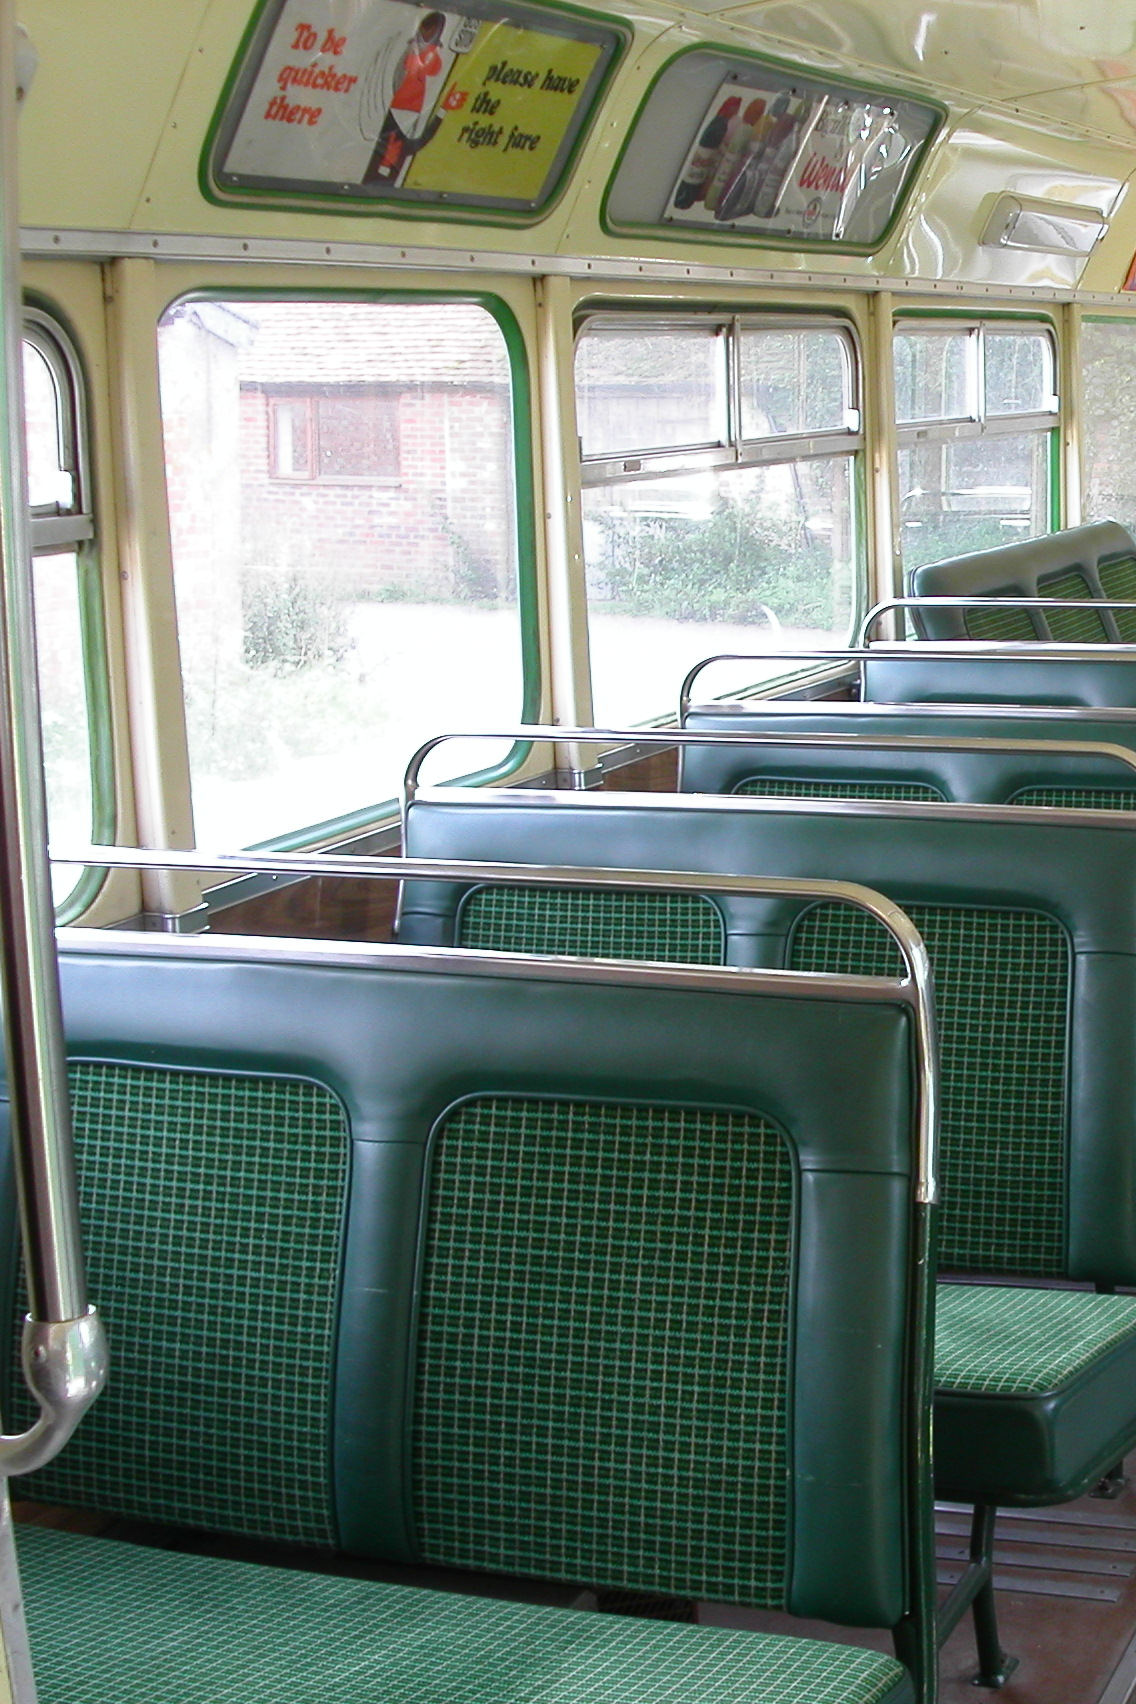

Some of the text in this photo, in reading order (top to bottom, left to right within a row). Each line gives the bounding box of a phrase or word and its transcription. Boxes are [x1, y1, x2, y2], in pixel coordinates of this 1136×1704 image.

[292, 23, 347, 56] To be
[278, 63, 358, 93] quicker
[484, 60, 580, 94] please have
[265, 95, 322, 126] there
[471, 92, 500, 115] the
[458, 121, 541, 151] right fare
